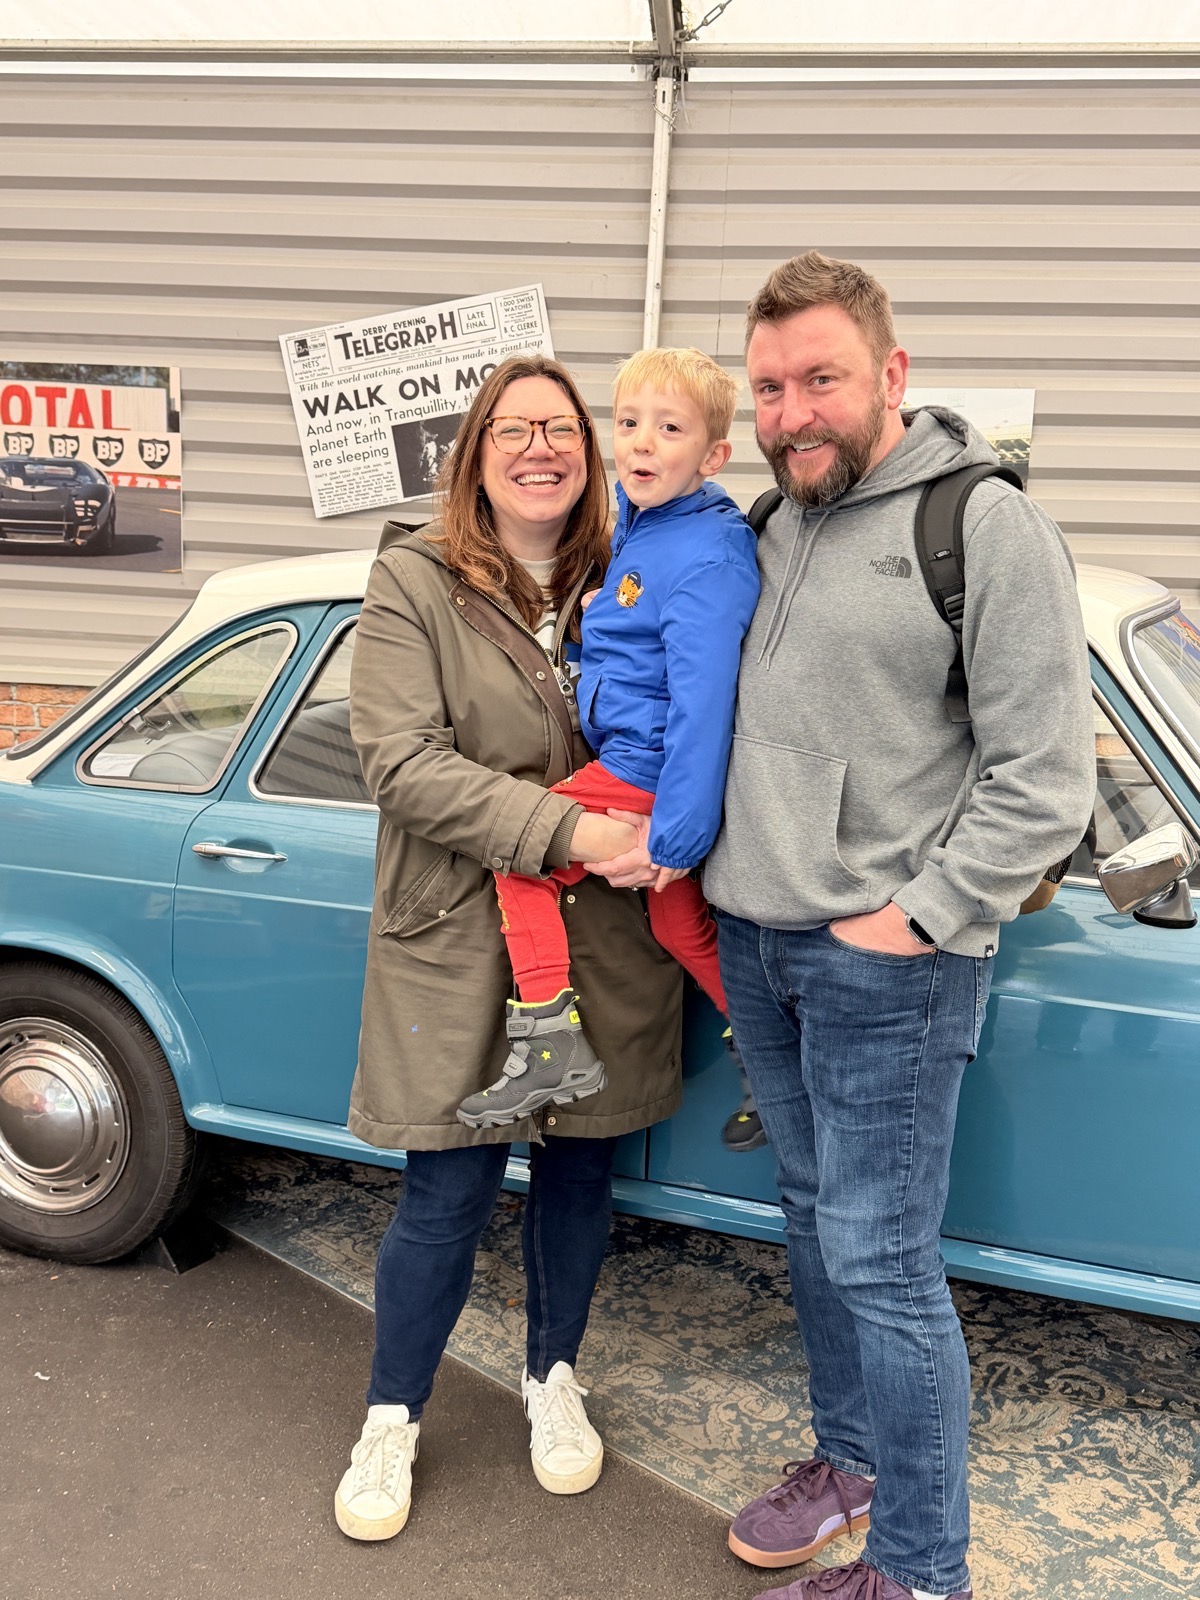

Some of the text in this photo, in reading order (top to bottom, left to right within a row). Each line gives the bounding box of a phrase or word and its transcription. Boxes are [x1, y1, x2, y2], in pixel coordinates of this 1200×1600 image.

[504, 303, 532, 312] WATCHES
[516, 295, 534, 304] SWISS
[466, 320, 488, 330] FINAL
[467, 311, 485, 320] LATE
[362, 316, 426, 336] DERBY EVENING
[517, 321, 538, 331] CLERKE
[300, 382, 318, 392] With
[321, 379, 334, 388] the
[338, 374, 360, 385] world
[363, 366, 403, 380] watching,
[406, 357, 442, 372] mankind
[445, 355, 459, 364] has
[462, 349, 485, 360] made
[488, 347, 498, 355] its
[500, 343, 522, 354] giant
[524, 340, 543, 349] leap
[302, 360, 320, 369] NETS
[302, 384, 387, 419] WALK
[398, 374, 441, 400] ON
[306, 420, 333, 436] And
[336, 417, 367, 431] now,
[369, 412, 381, 425] in
[385, 399, 461, 421] Tranquillity,
[7, 435, 33, 455] BP
[52, 438, 78, 457] BP
[96, 440, 122, 460] BP
[309, 428, 387, 456] planet Earth
[142, 442, 168, 462] BP
[313, 446, 389, 469] are sleeping
[869, 560, 897, 570] NORTH
[875, 568, 895, 576] FACE
